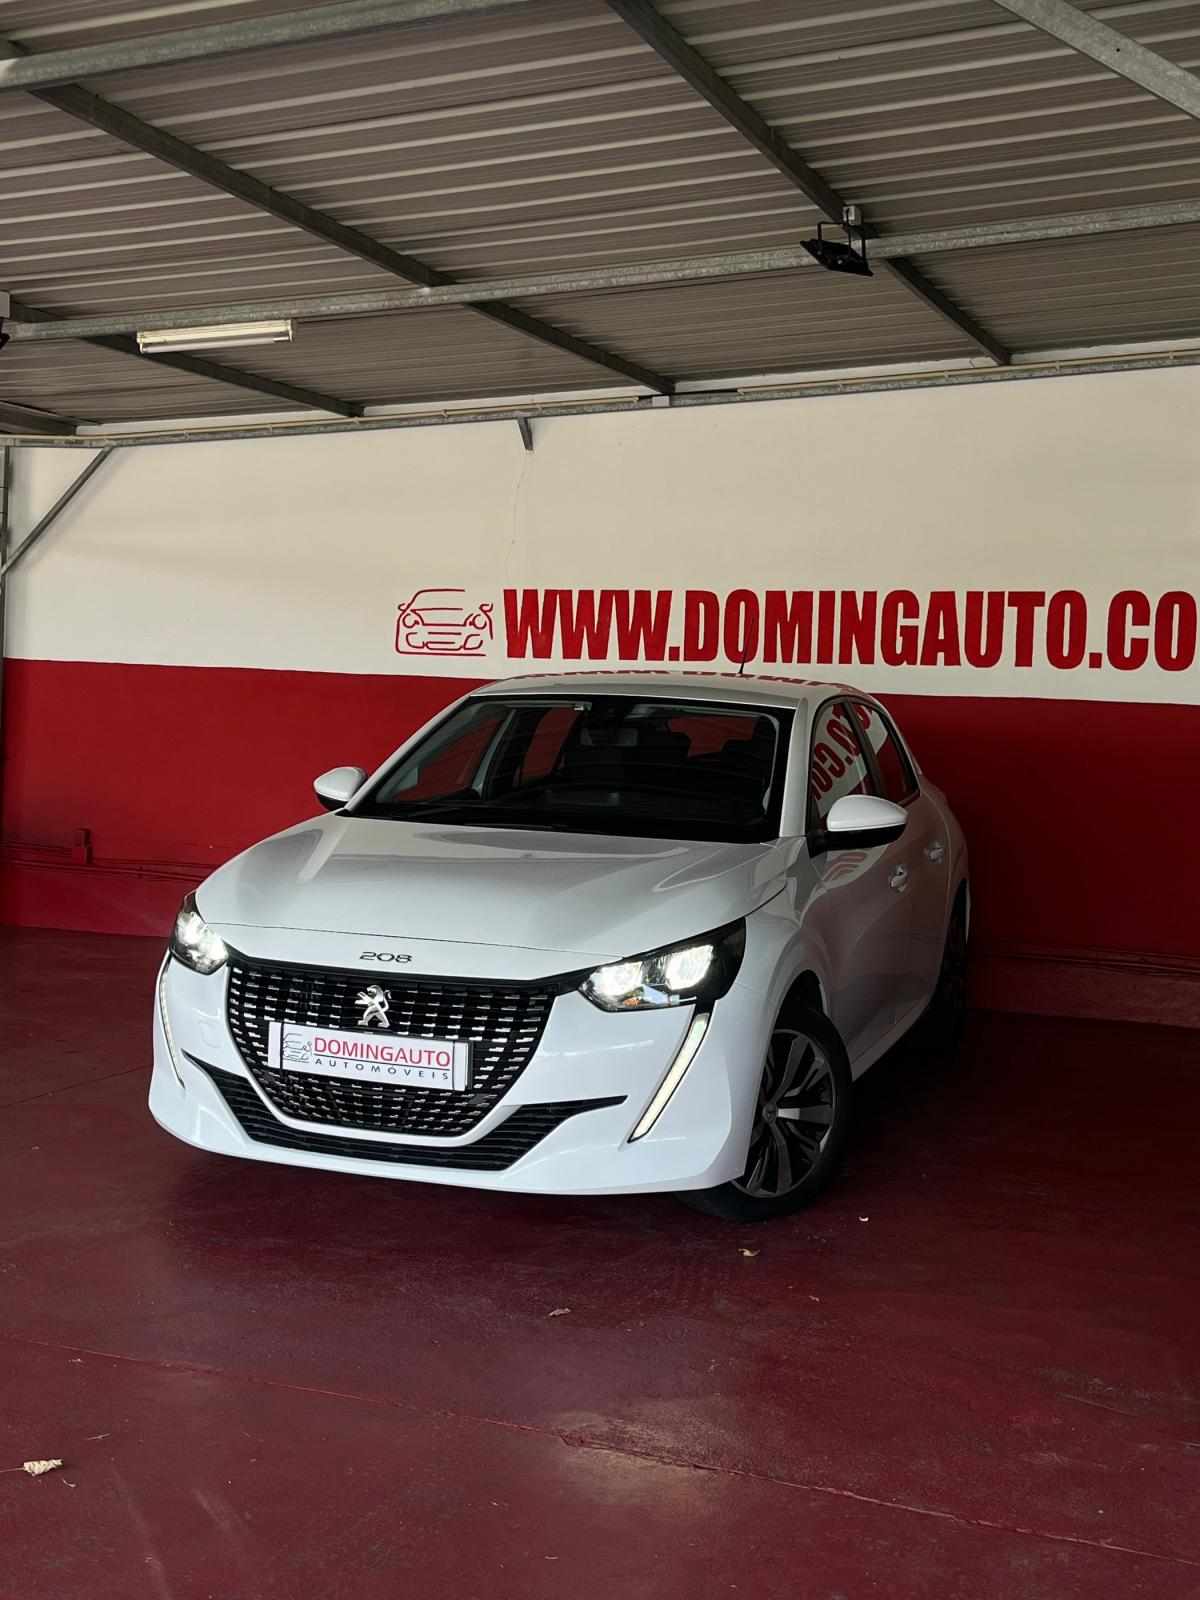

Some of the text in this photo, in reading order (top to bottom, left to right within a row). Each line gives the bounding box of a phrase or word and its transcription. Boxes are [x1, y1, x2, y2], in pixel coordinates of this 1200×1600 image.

[503, 589, 1197, 671] WWW.DOMINGAUTO.CO
[359, 951, 412, 964] 208
[314, 1037, 450, 1067] DOMINGAUTO
